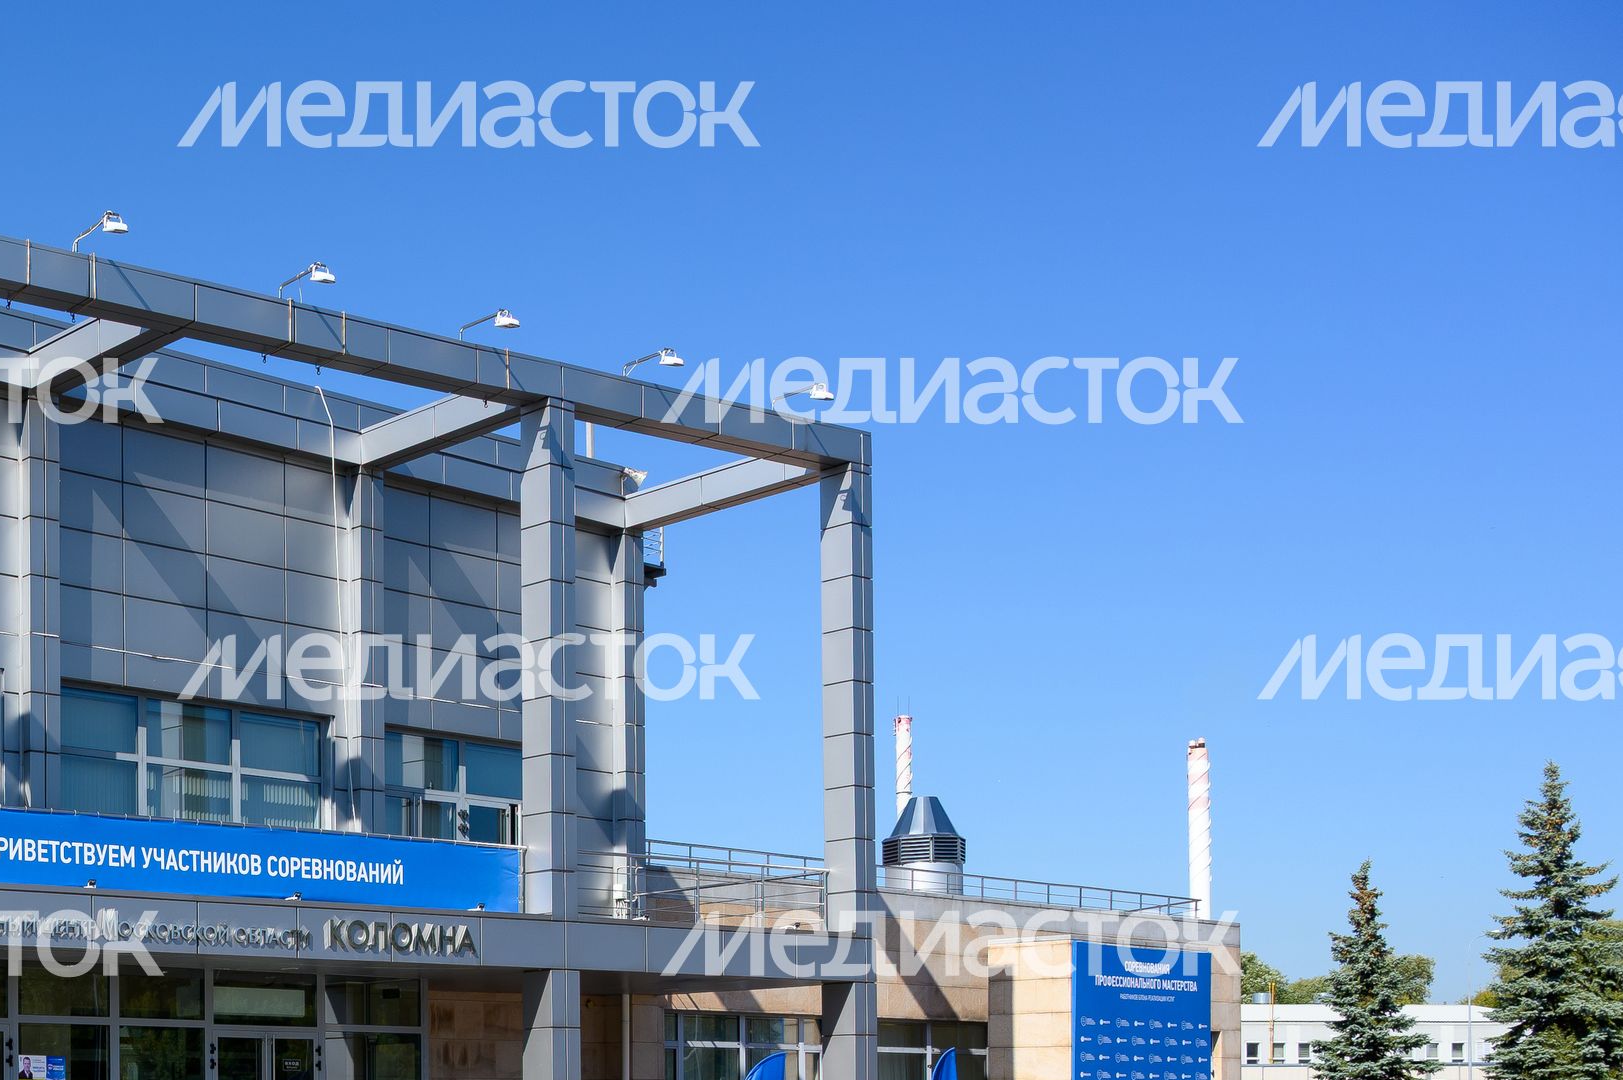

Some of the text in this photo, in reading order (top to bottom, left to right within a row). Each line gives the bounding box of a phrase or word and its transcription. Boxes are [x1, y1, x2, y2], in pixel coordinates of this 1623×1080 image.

[142, 847, 262, 876] УЧАСТНИКОВ
[266, 856, 404, 886] СОРЕВНОВАНИЙ
[326, 917, 479, 957] КОЛОМНА
